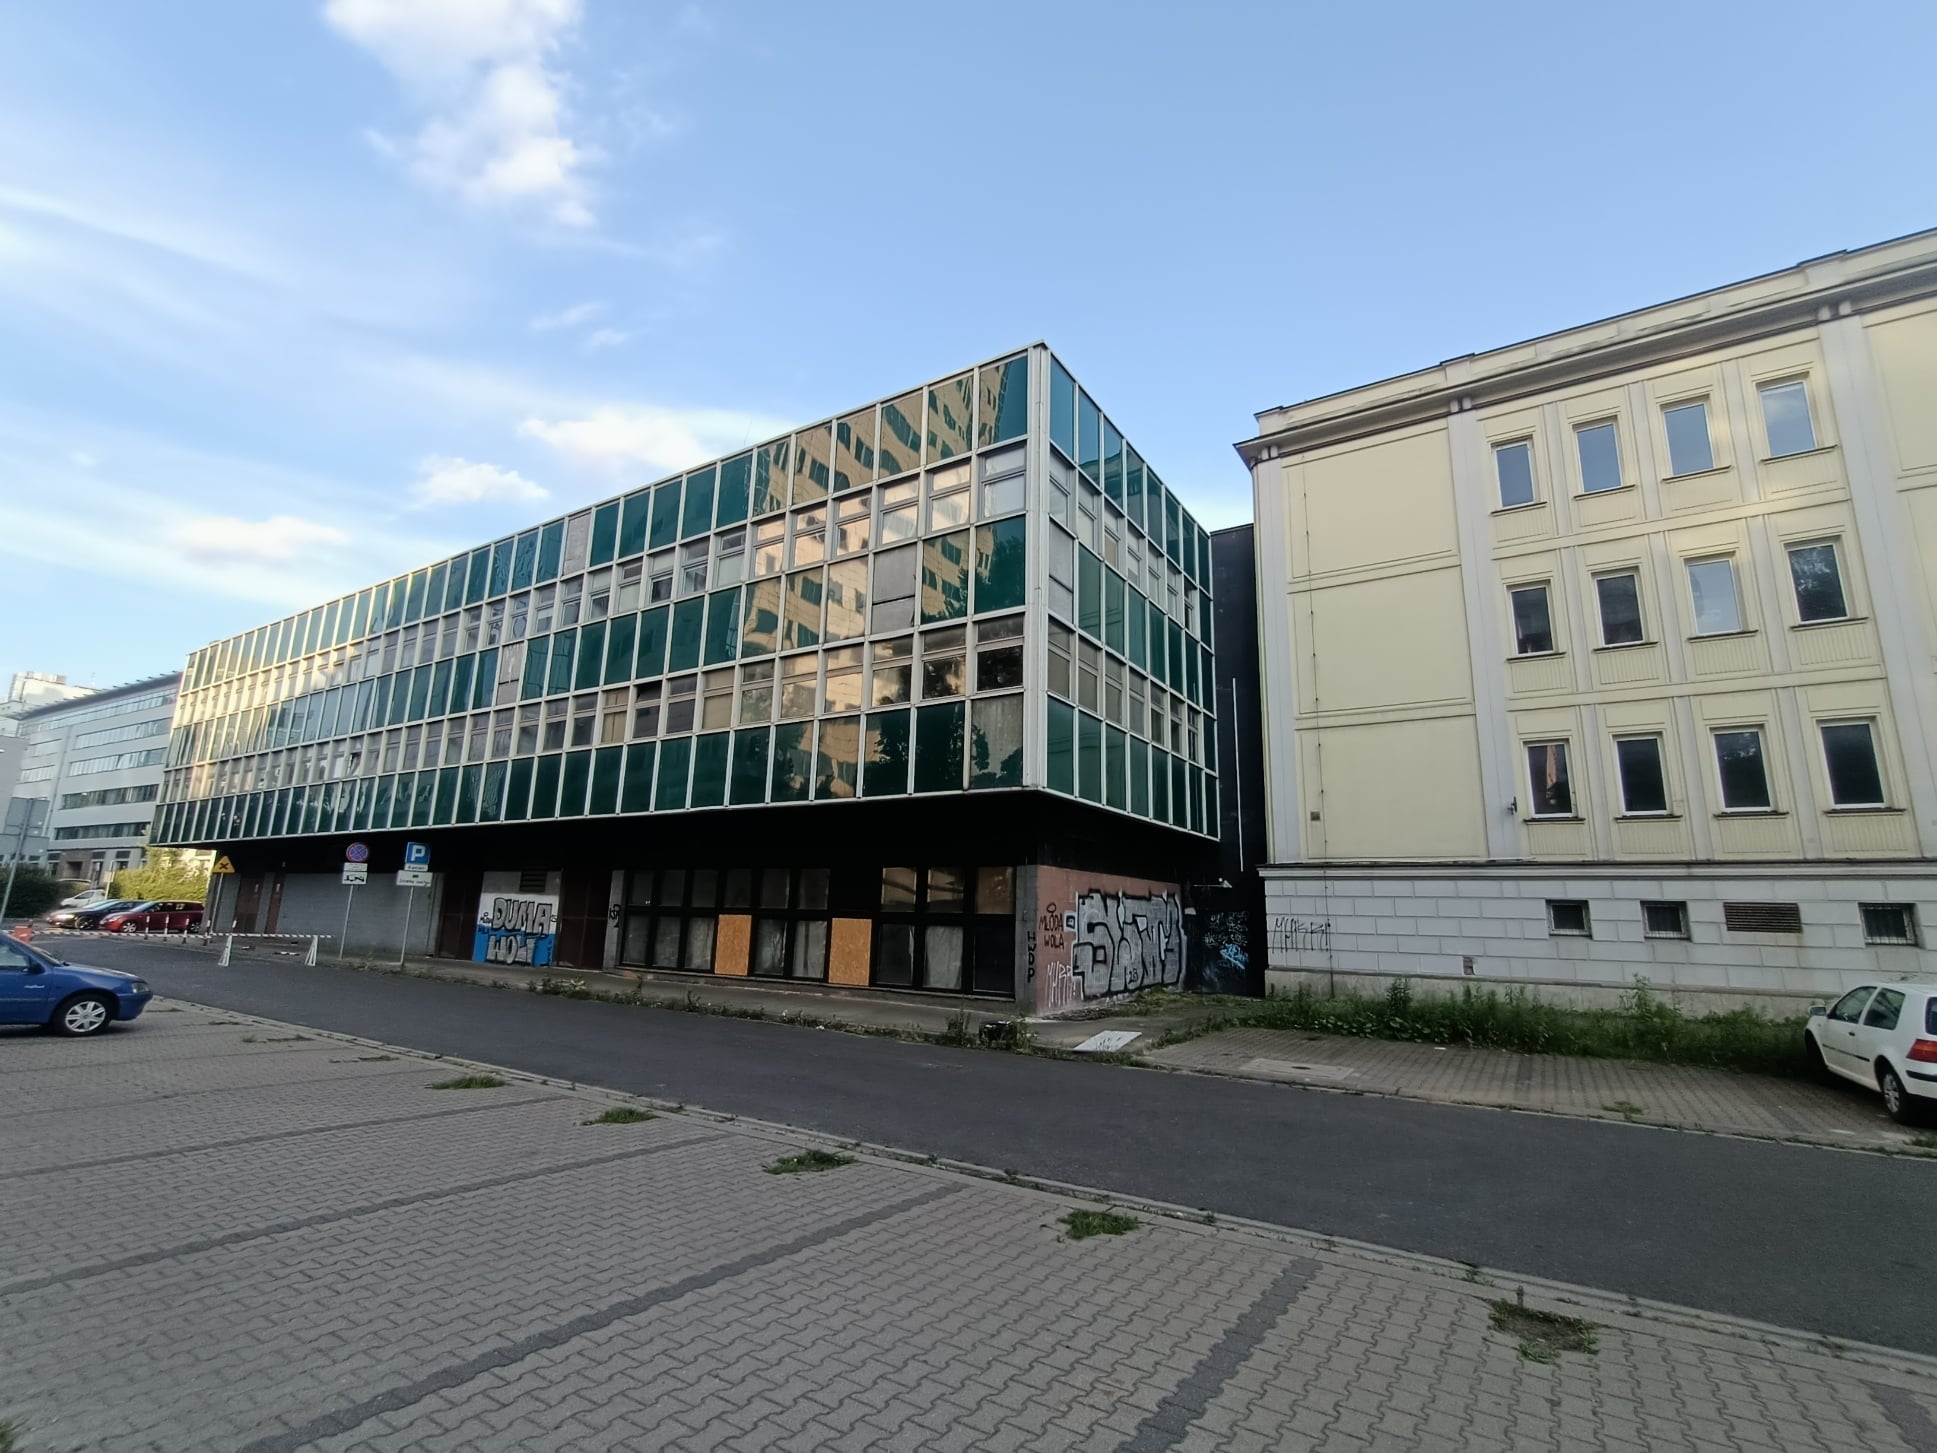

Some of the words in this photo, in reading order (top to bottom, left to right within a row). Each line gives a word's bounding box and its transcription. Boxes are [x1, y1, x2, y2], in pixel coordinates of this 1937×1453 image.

[411, 844, 426, 861] P
[492, 897, 553, 935] DUMA
[1043, 933, 1065, 950] WOLA
[1027, 931, 1037, 983] HWDP
